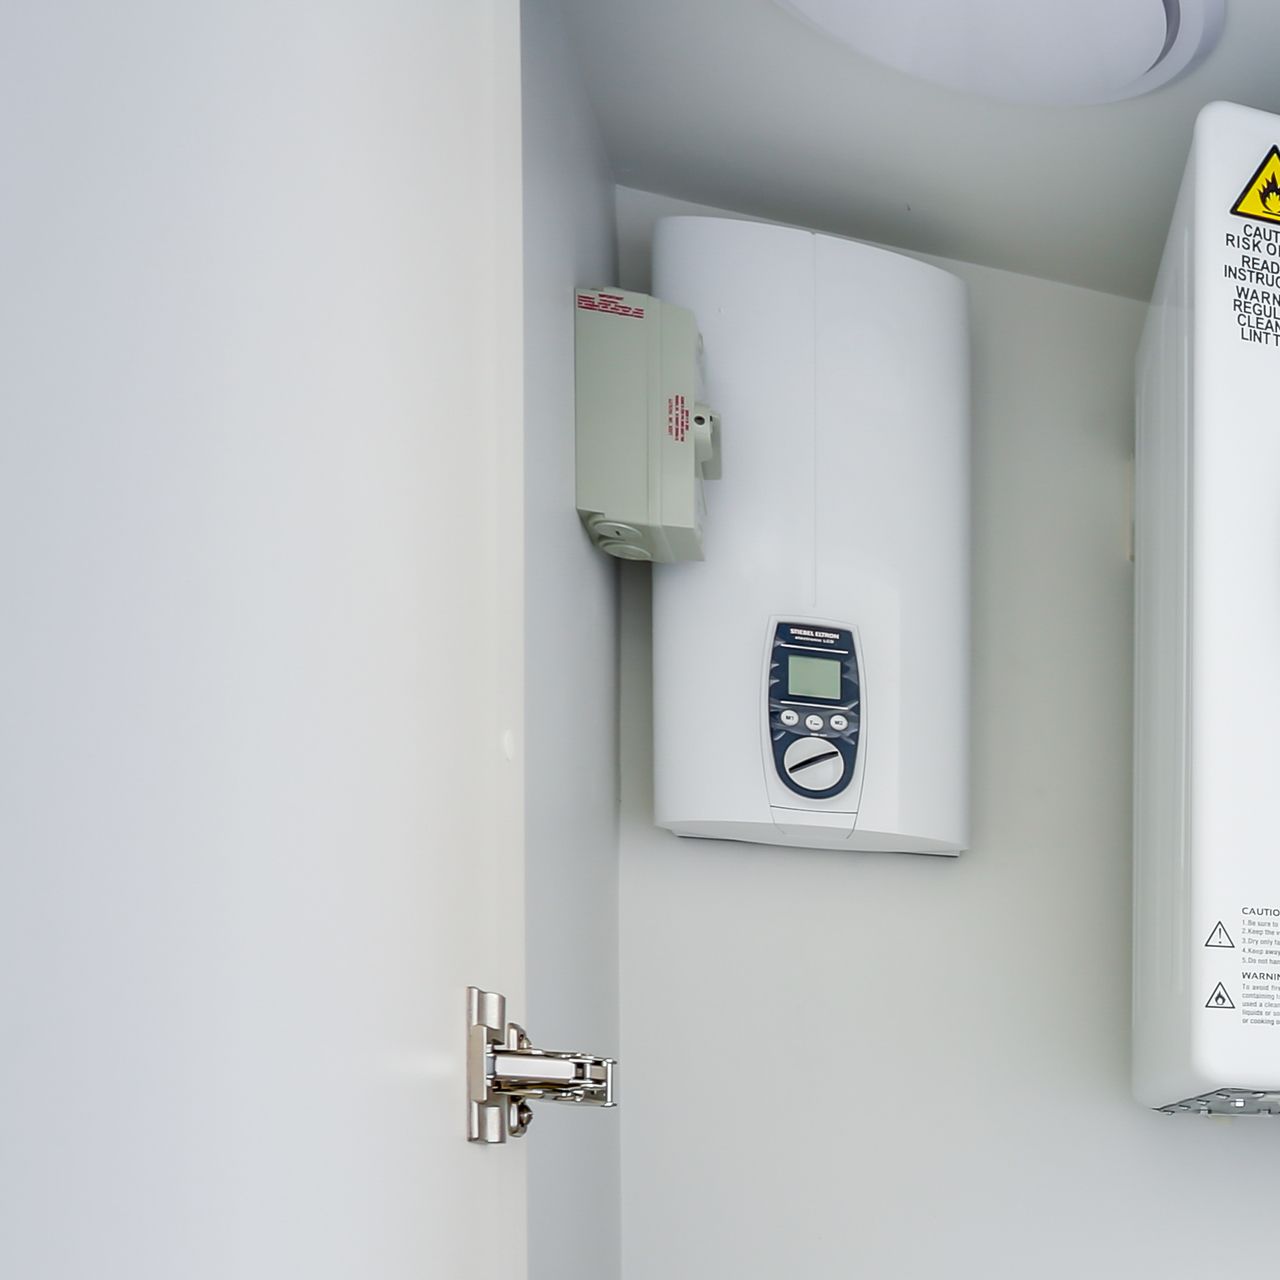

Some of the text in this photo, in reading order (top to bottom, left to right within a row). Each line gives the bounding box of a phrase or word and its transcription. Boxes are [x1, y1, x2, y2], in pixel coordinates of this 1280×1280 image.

[1226, 233, 1261, 253] RISK
[1242, 255, 1280, 274] READ
[1241, 327, 1271, 344] LINT
[790, 628, 840, 640] STIEBEL ELTRON
